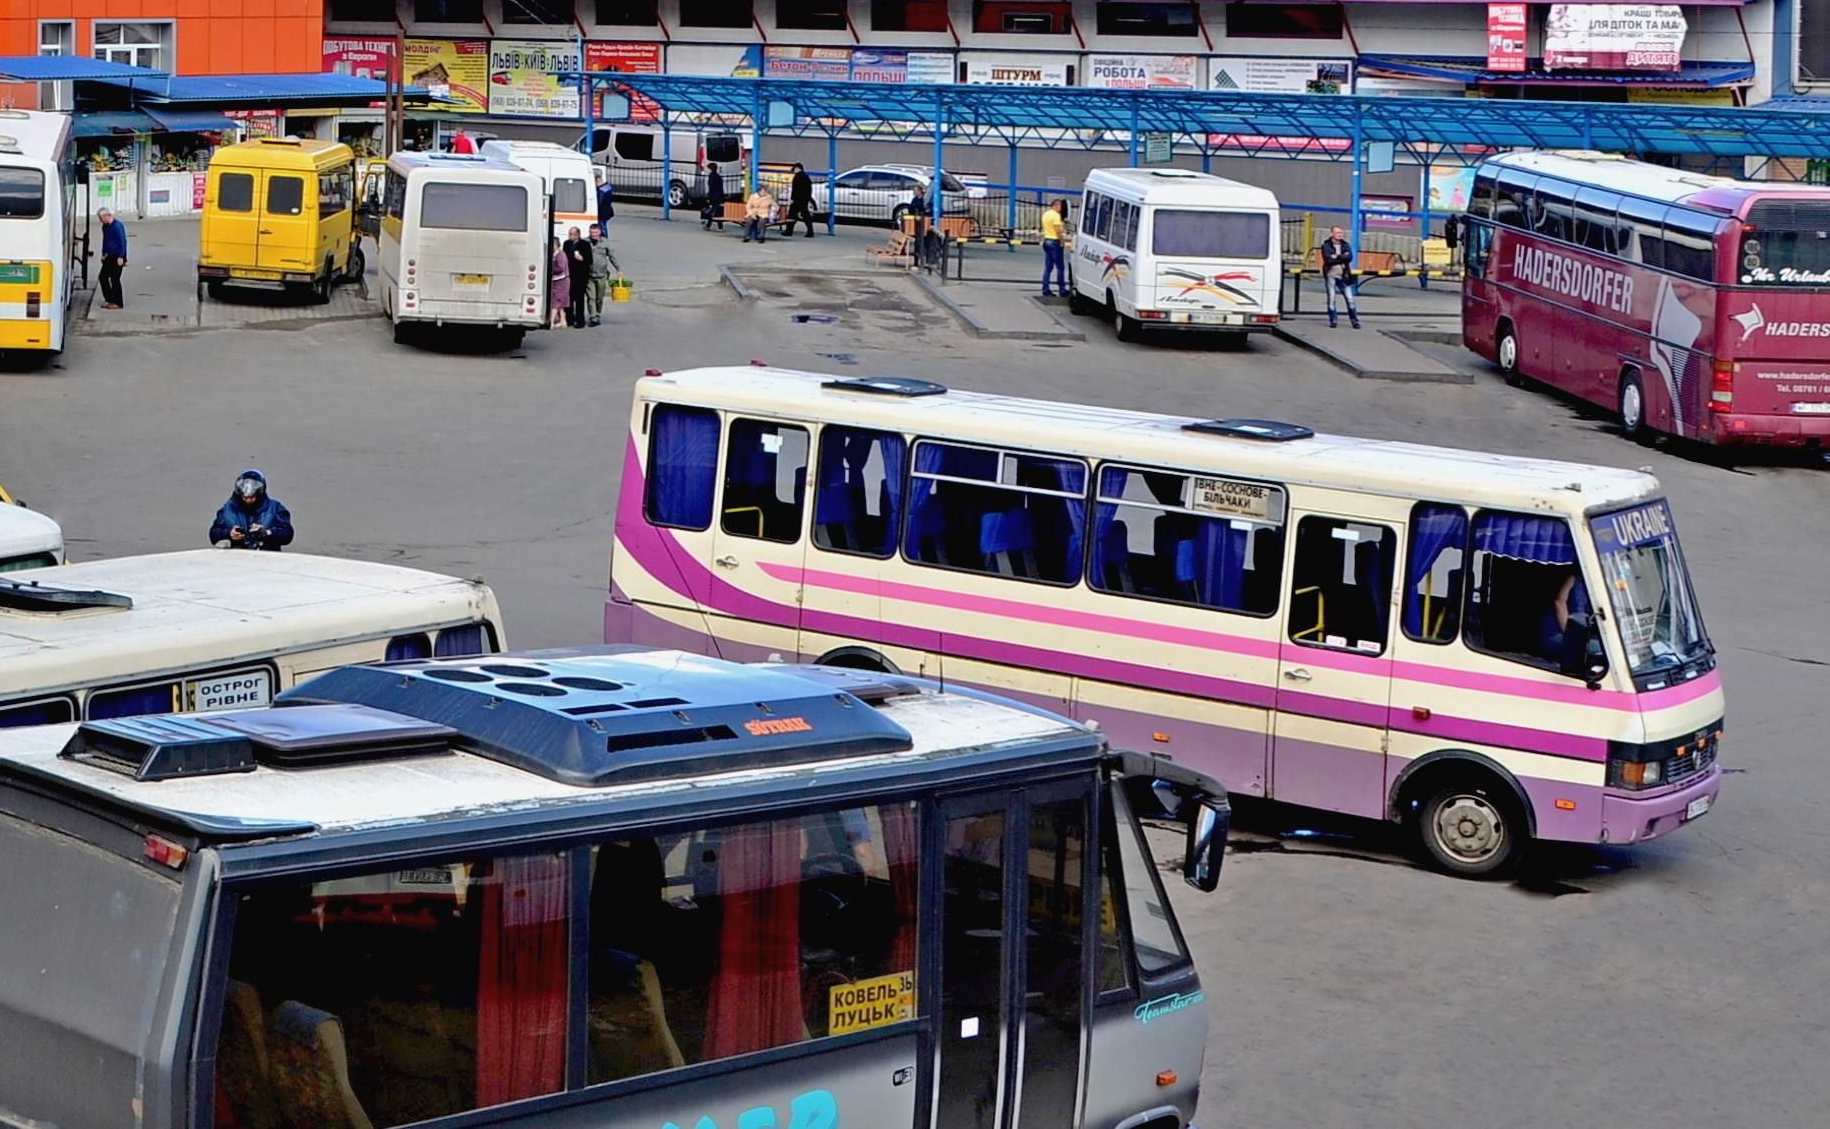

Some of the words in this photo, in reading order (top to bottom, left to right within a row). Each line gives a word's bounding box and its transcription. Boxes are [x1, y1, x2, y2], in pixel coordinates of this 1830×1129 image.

[1611, 19, 1643, 30] ДІТОК
[1645, 20, 1659, 30] ТА
[991, 69, 1042, 81] ШТУРМ
[1093, 66, 1147, 79] РОБОТА
[1513, 243, 1634, 315] HADERSDORFER
[1612, 505, 1670, 547] UKRAINE
[201, 677, 263, 696] ОСТРОГ
[206, 691, 259, 708] РІВНЕ
[834, 983, 897, 1008] КОВЕЛЬ
[833, 1003, 895, 1029] ЛУЦЬК
